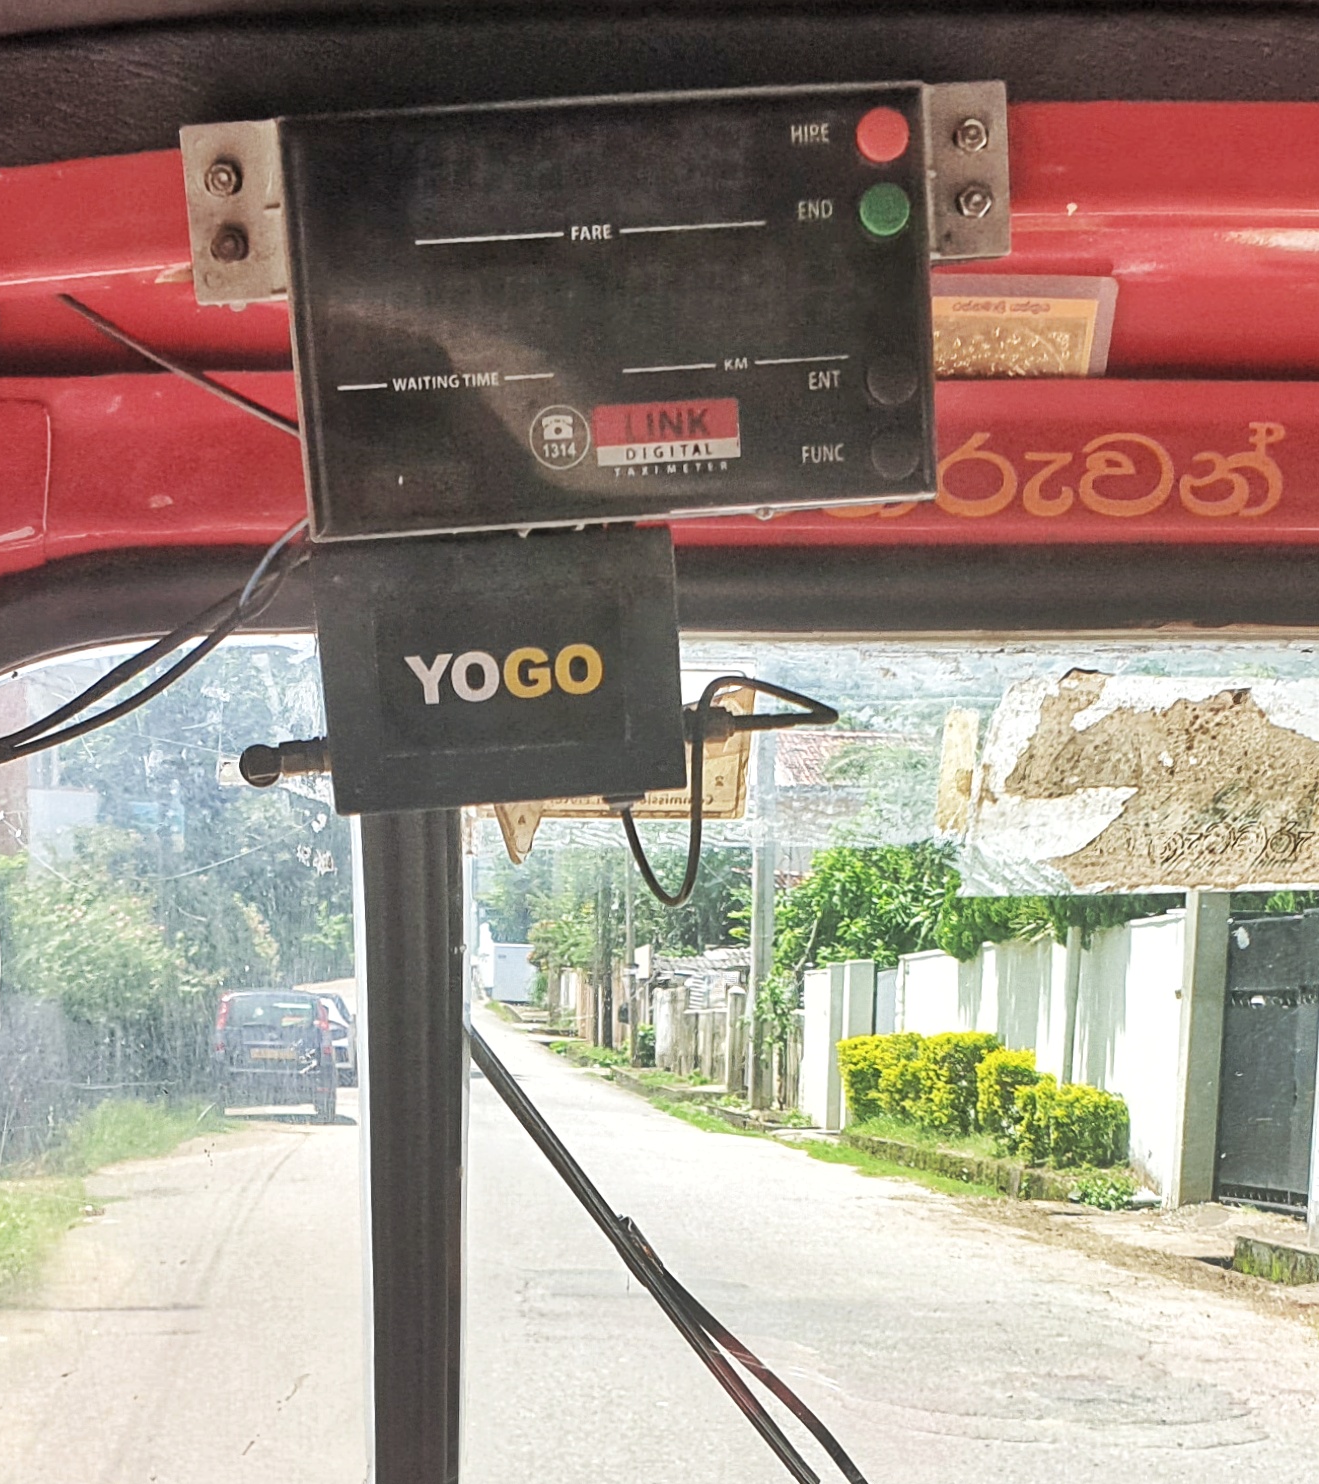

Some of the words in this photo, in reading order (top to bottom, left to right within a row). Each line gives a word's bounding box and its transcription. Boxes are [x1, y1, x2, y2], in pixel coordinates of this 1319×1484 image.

[790, 123, 830, 145] HIRE
[797, 200, 834, 221] END
[570, 224, 613, 241] FARE
[725, 357, 748, 371] KM
[392, 374, 460, 392] WAITING
[462, 372, 500, 388] TIME
[808, 371, 840, 391] ENT
[626, 408, 710, 443] LINK
[542, 442, 576, 458] 1314
[625, 443, 713, 462] DIGITAL
[801, 443, 845, 464] FUNC
[614, 460, 728, 478] TAXIMETER
[404, 643, 604, 705] YOGO
